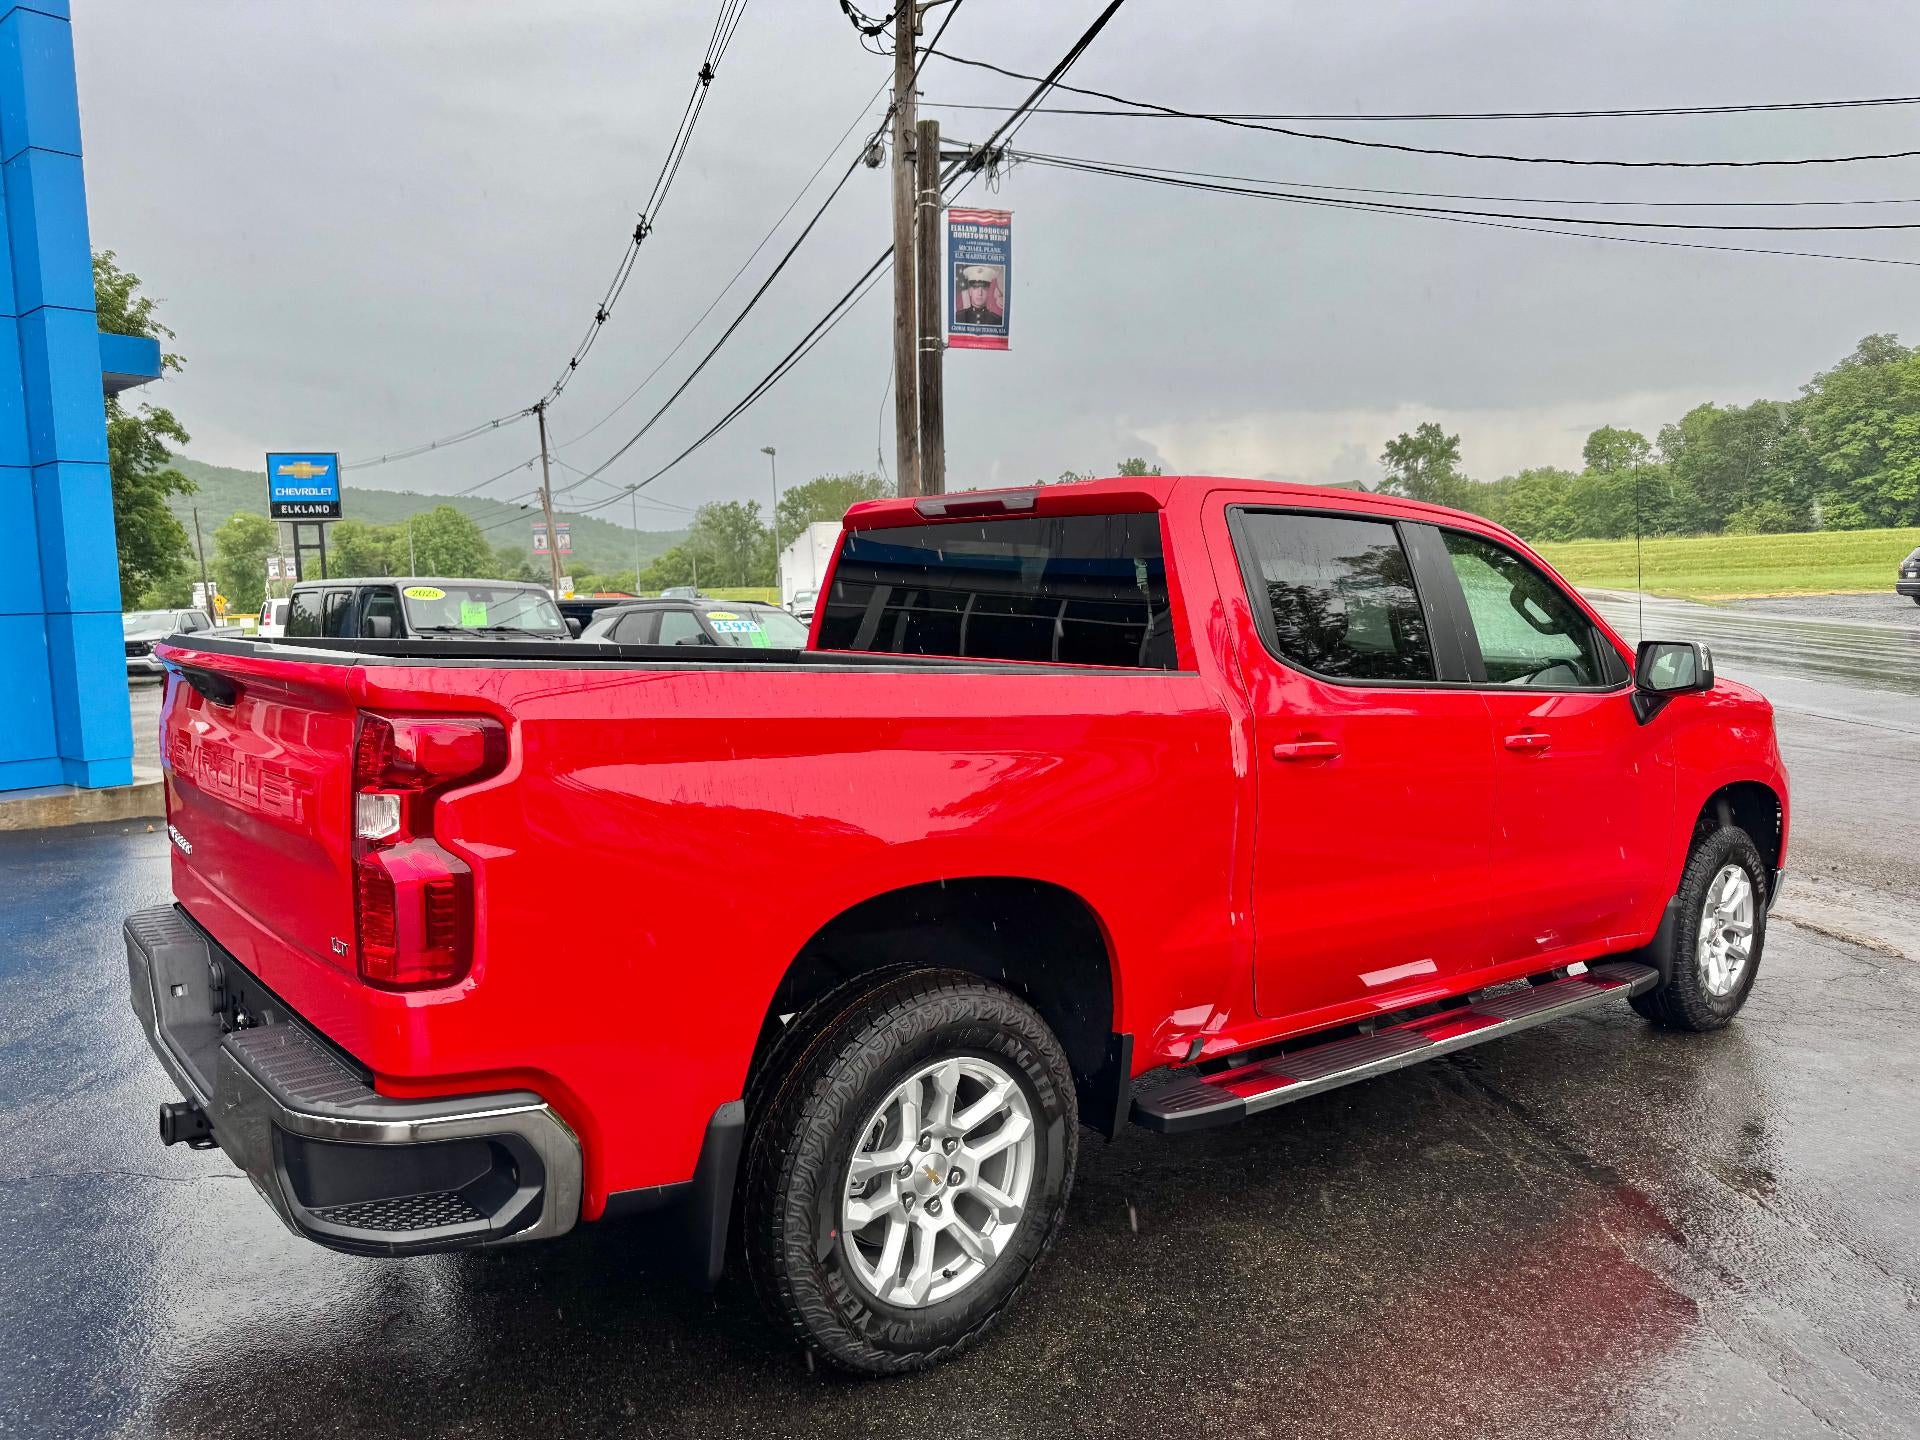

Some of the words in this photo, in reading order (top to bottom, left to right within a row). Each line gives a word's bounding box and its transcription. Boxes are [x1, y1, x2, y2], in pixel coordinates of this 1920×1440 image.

[951, 224, 977, 232] ELKLAND
[979, 226, 1009, 235] BOROUGH
[275, 487, 332, 496] CHEVROLET
[281, 504, 330, 514] ELKLAND
[167, 733, 315, 824] EVROLET
